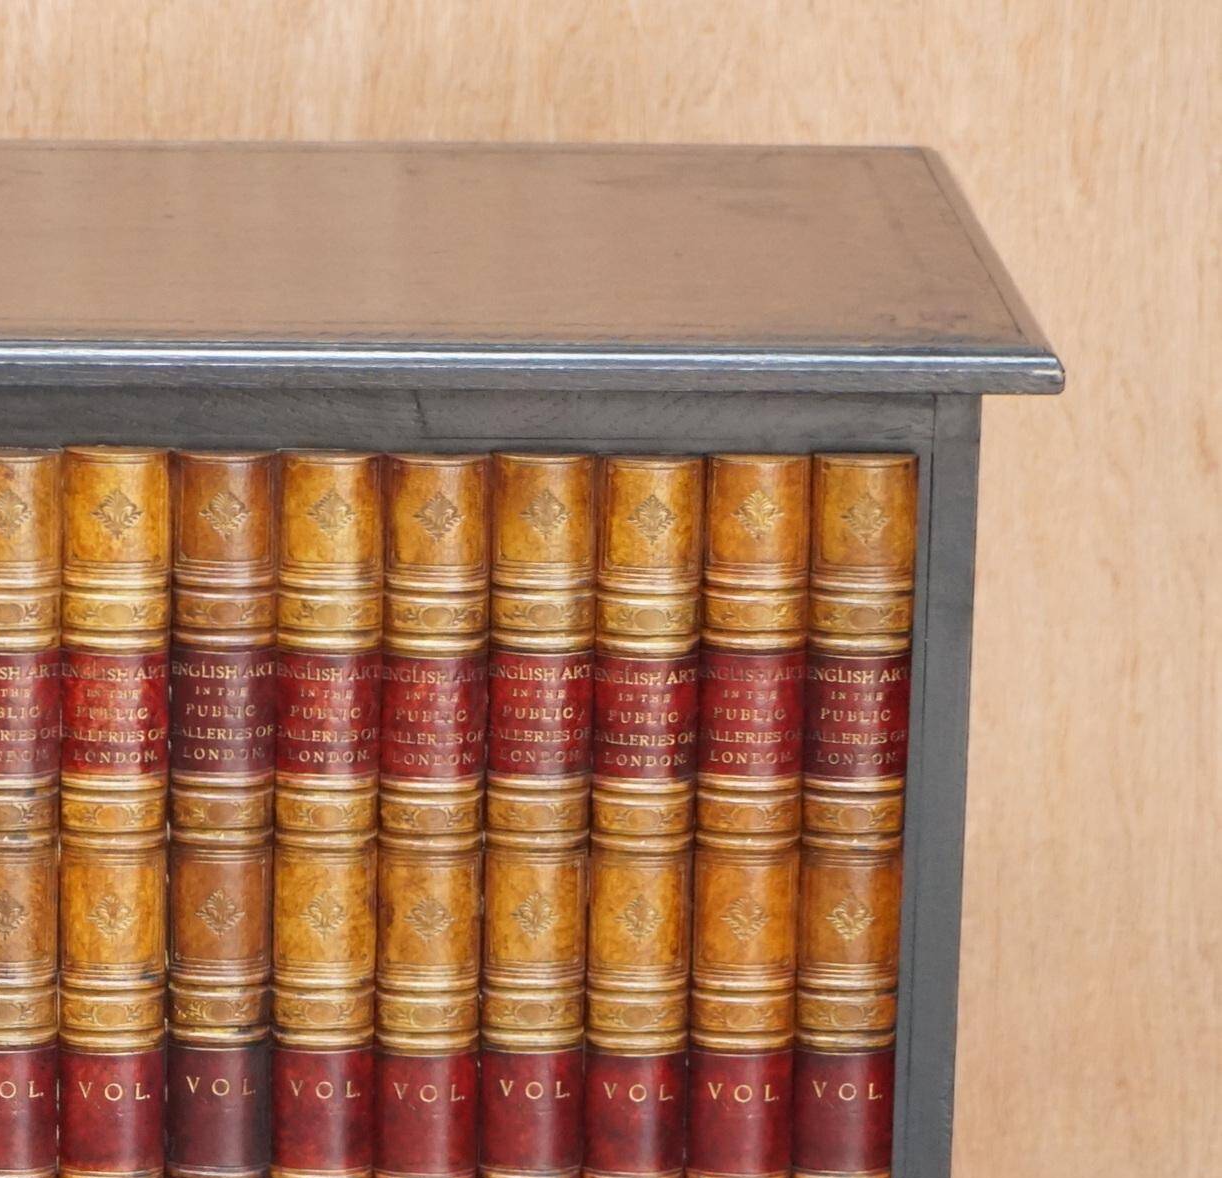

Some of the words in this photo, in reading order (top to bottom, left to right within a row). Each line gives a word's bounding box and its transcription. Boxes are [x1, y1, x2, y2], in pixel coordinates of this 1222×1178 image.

[172, 661, 238, 680] ENGLISH
[245, 662, 275, 677] ART
[562, 663, 591, 680] ART
[186, 703, 255, 717] PUBLIC
[289, 705, 361, 720] PUBLIC
[502, 706, 573, 720] PUBLIC
[608, 709, 679, 724] PUBLIC
[714, 708, 785, 722] PUBLIC
[821, 708, 890, 722] PUBLIC
[79, 1081, 149, 1100] VOL.
[186, 1076, 255, 1096] VOL.
[291, 1079, 360, 1098] VOL.
[394, 1082, 464, 1102] VOL.
[499, 1079, 569, 1099] VOL.
[603, 1082, 672, 1101] VOL.
[708, 1082, 778, 1102] VOL.
[813, 1080, 881, 1100] VOL.
